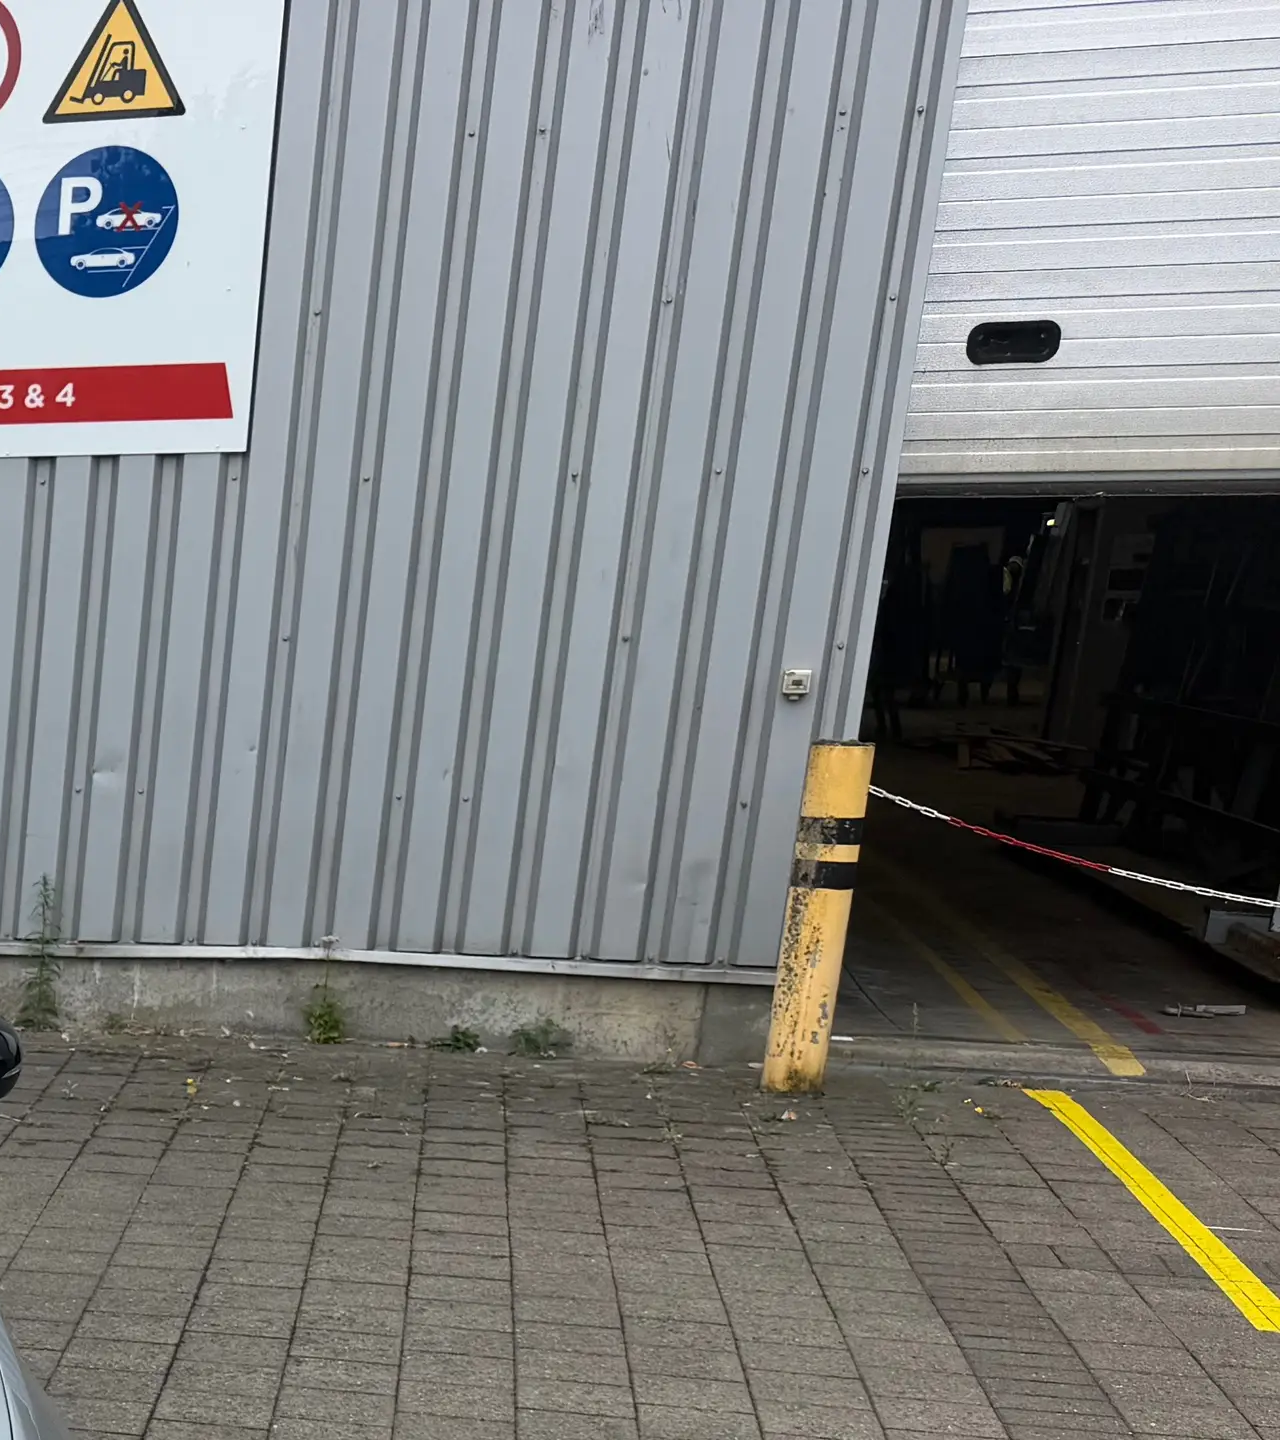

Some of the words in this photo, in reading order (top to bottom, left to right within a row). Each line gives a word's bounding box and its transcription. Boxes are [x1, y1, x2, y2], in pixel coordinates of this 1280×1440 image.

[57, 176, 104, 236] P
[23, 385, 44, 408] &
[55, 383, 75, 407] 4
